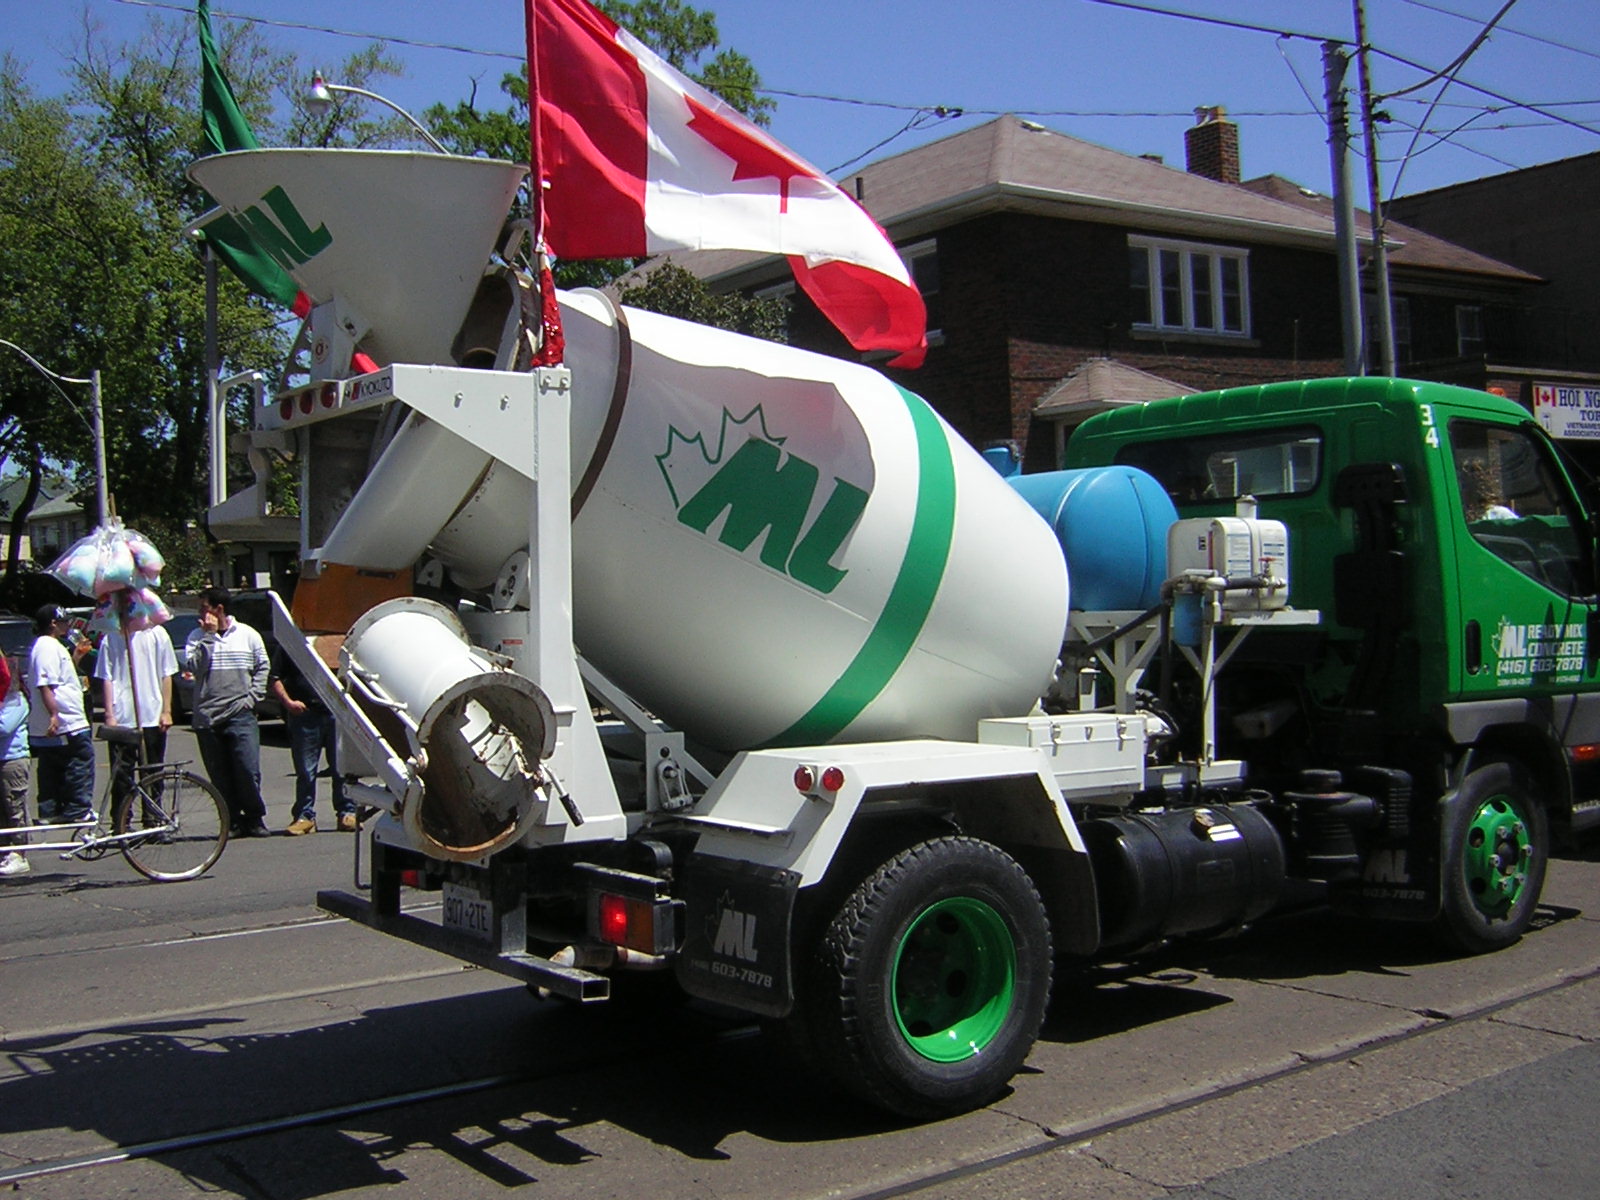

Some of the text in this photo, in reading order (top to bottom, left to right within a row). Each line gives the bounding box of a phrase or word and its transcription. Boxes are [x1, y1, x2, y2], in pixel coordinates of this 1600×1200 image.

[677, 437, 870, 594] ML
[1499, 625, 1526, 658] ML
[1528, 624, 1563, 639] READY
[1528, 641, 1585, 657] CONCRETE
[714, 908, 758, 962] ML
